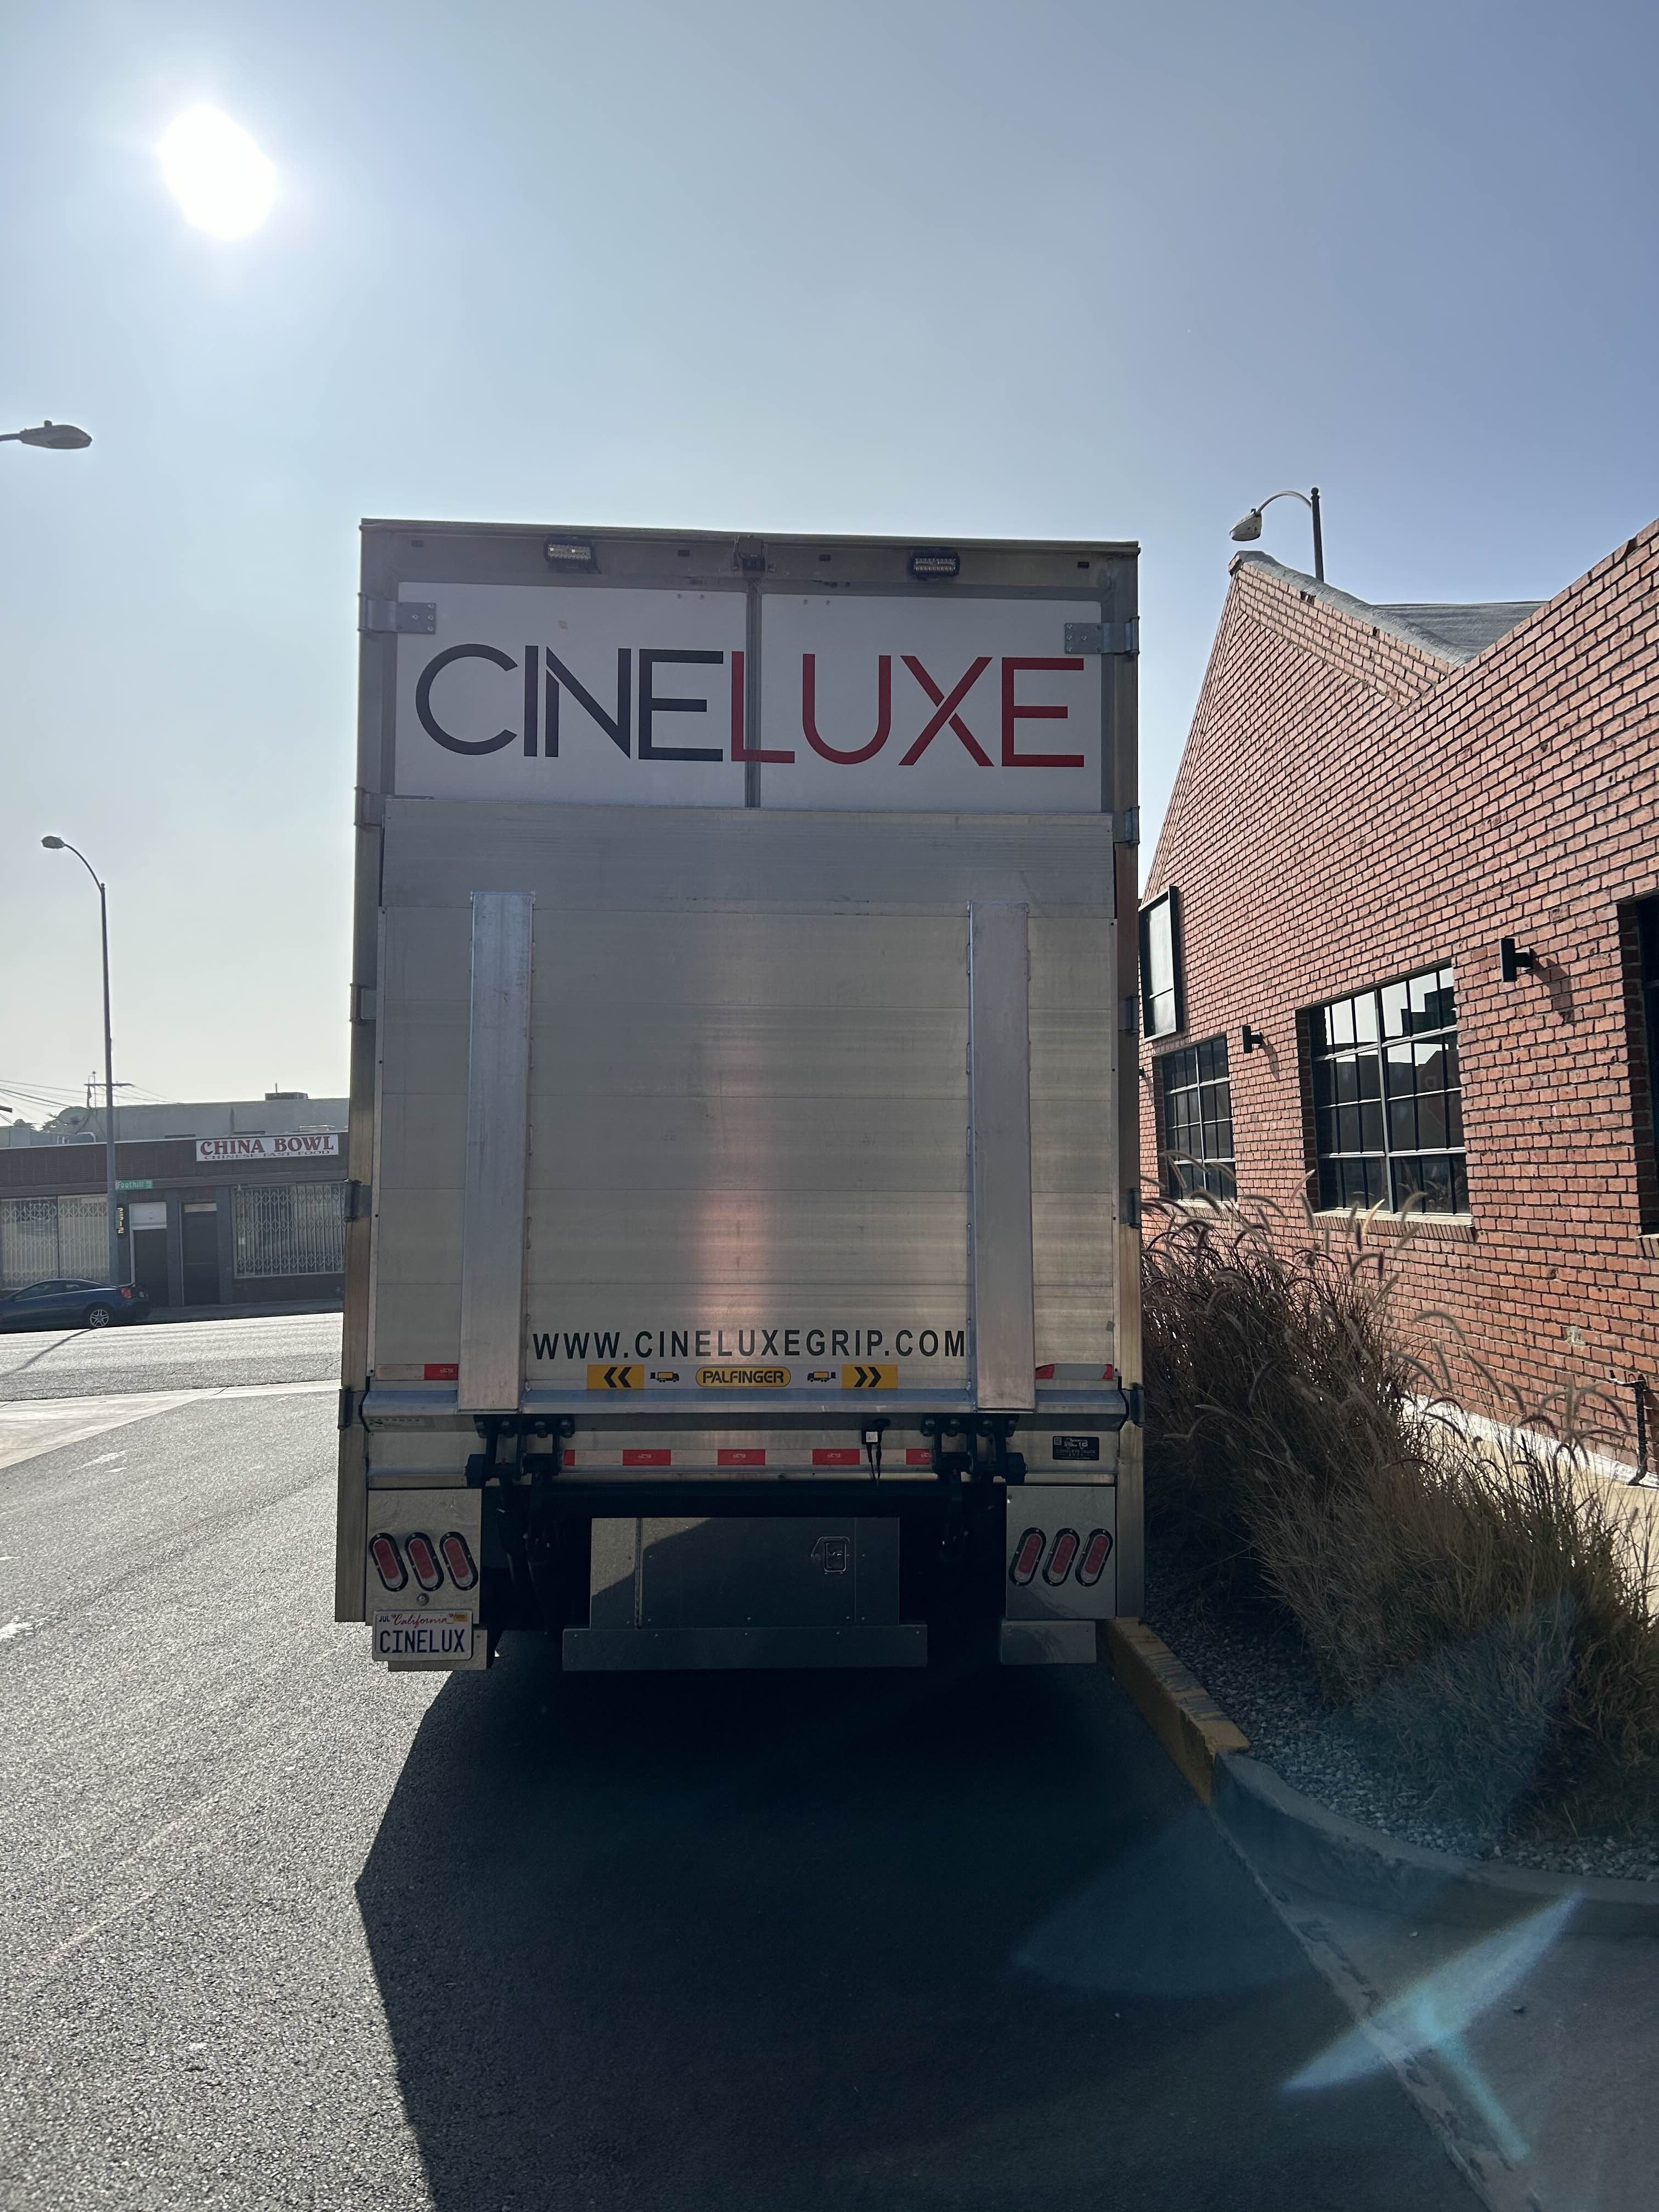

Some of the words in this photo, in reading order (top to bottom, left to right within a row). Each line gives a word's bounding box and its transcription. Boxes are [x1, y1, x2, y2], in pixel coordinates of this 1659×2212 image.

[415, 643, 1085, 767] CINELUXE
[200, 1139, 264, 1155] CHINA
[274, 1136, 334, 1152] BOWL
[117, 1181, 144, 1189] Foothill
[533, 1329, 966, 1360] WWW.CINELUXEGRIP.COM
[702, 1370, 784, 1384] PALFINGER
[394, 1613, 448, 1628] California
[380, 1629, 465, 1654] CINELUX
